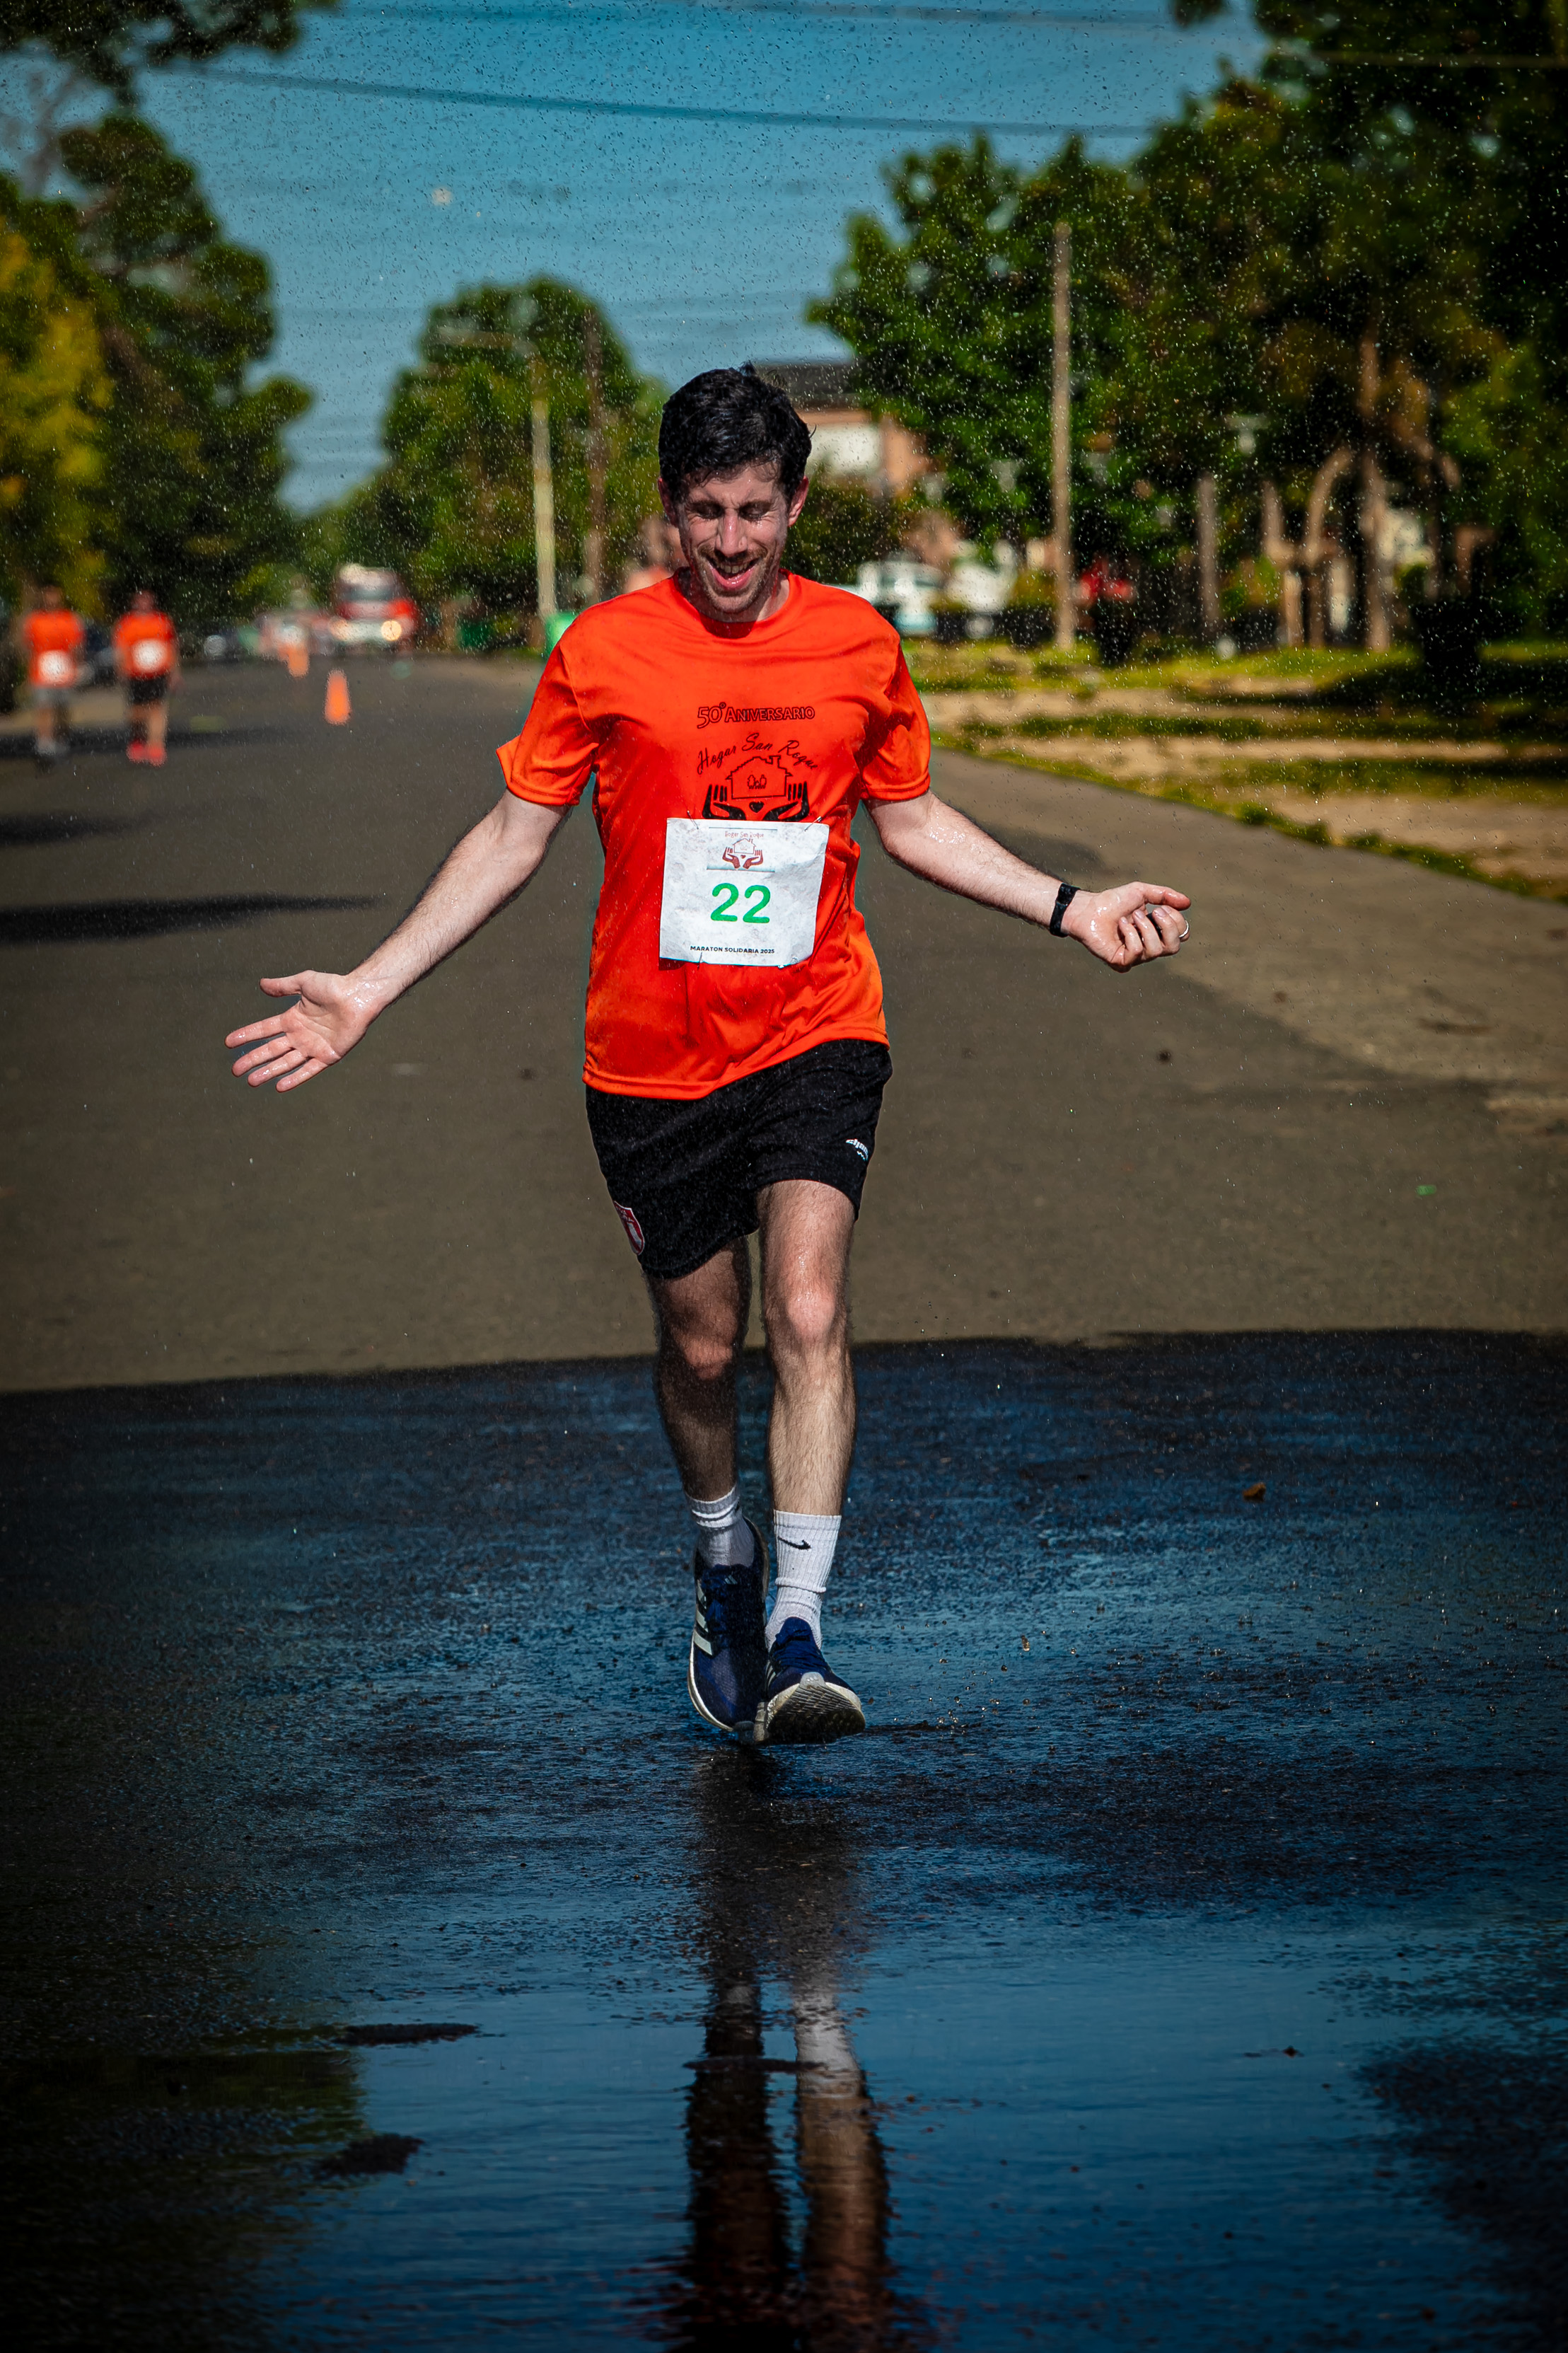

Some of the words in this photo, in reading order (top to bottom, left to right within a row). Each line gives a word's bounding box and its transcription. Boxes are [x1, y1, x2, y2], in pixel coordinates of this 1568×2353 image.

[724, 706, 815, 723] ANIVERSARIO
[697, 746, 737, 775] Hogar
[741, 732, 774, 752] San
[777, 740, 819, 770] Roque
[709, 882, 772, 924] 22
